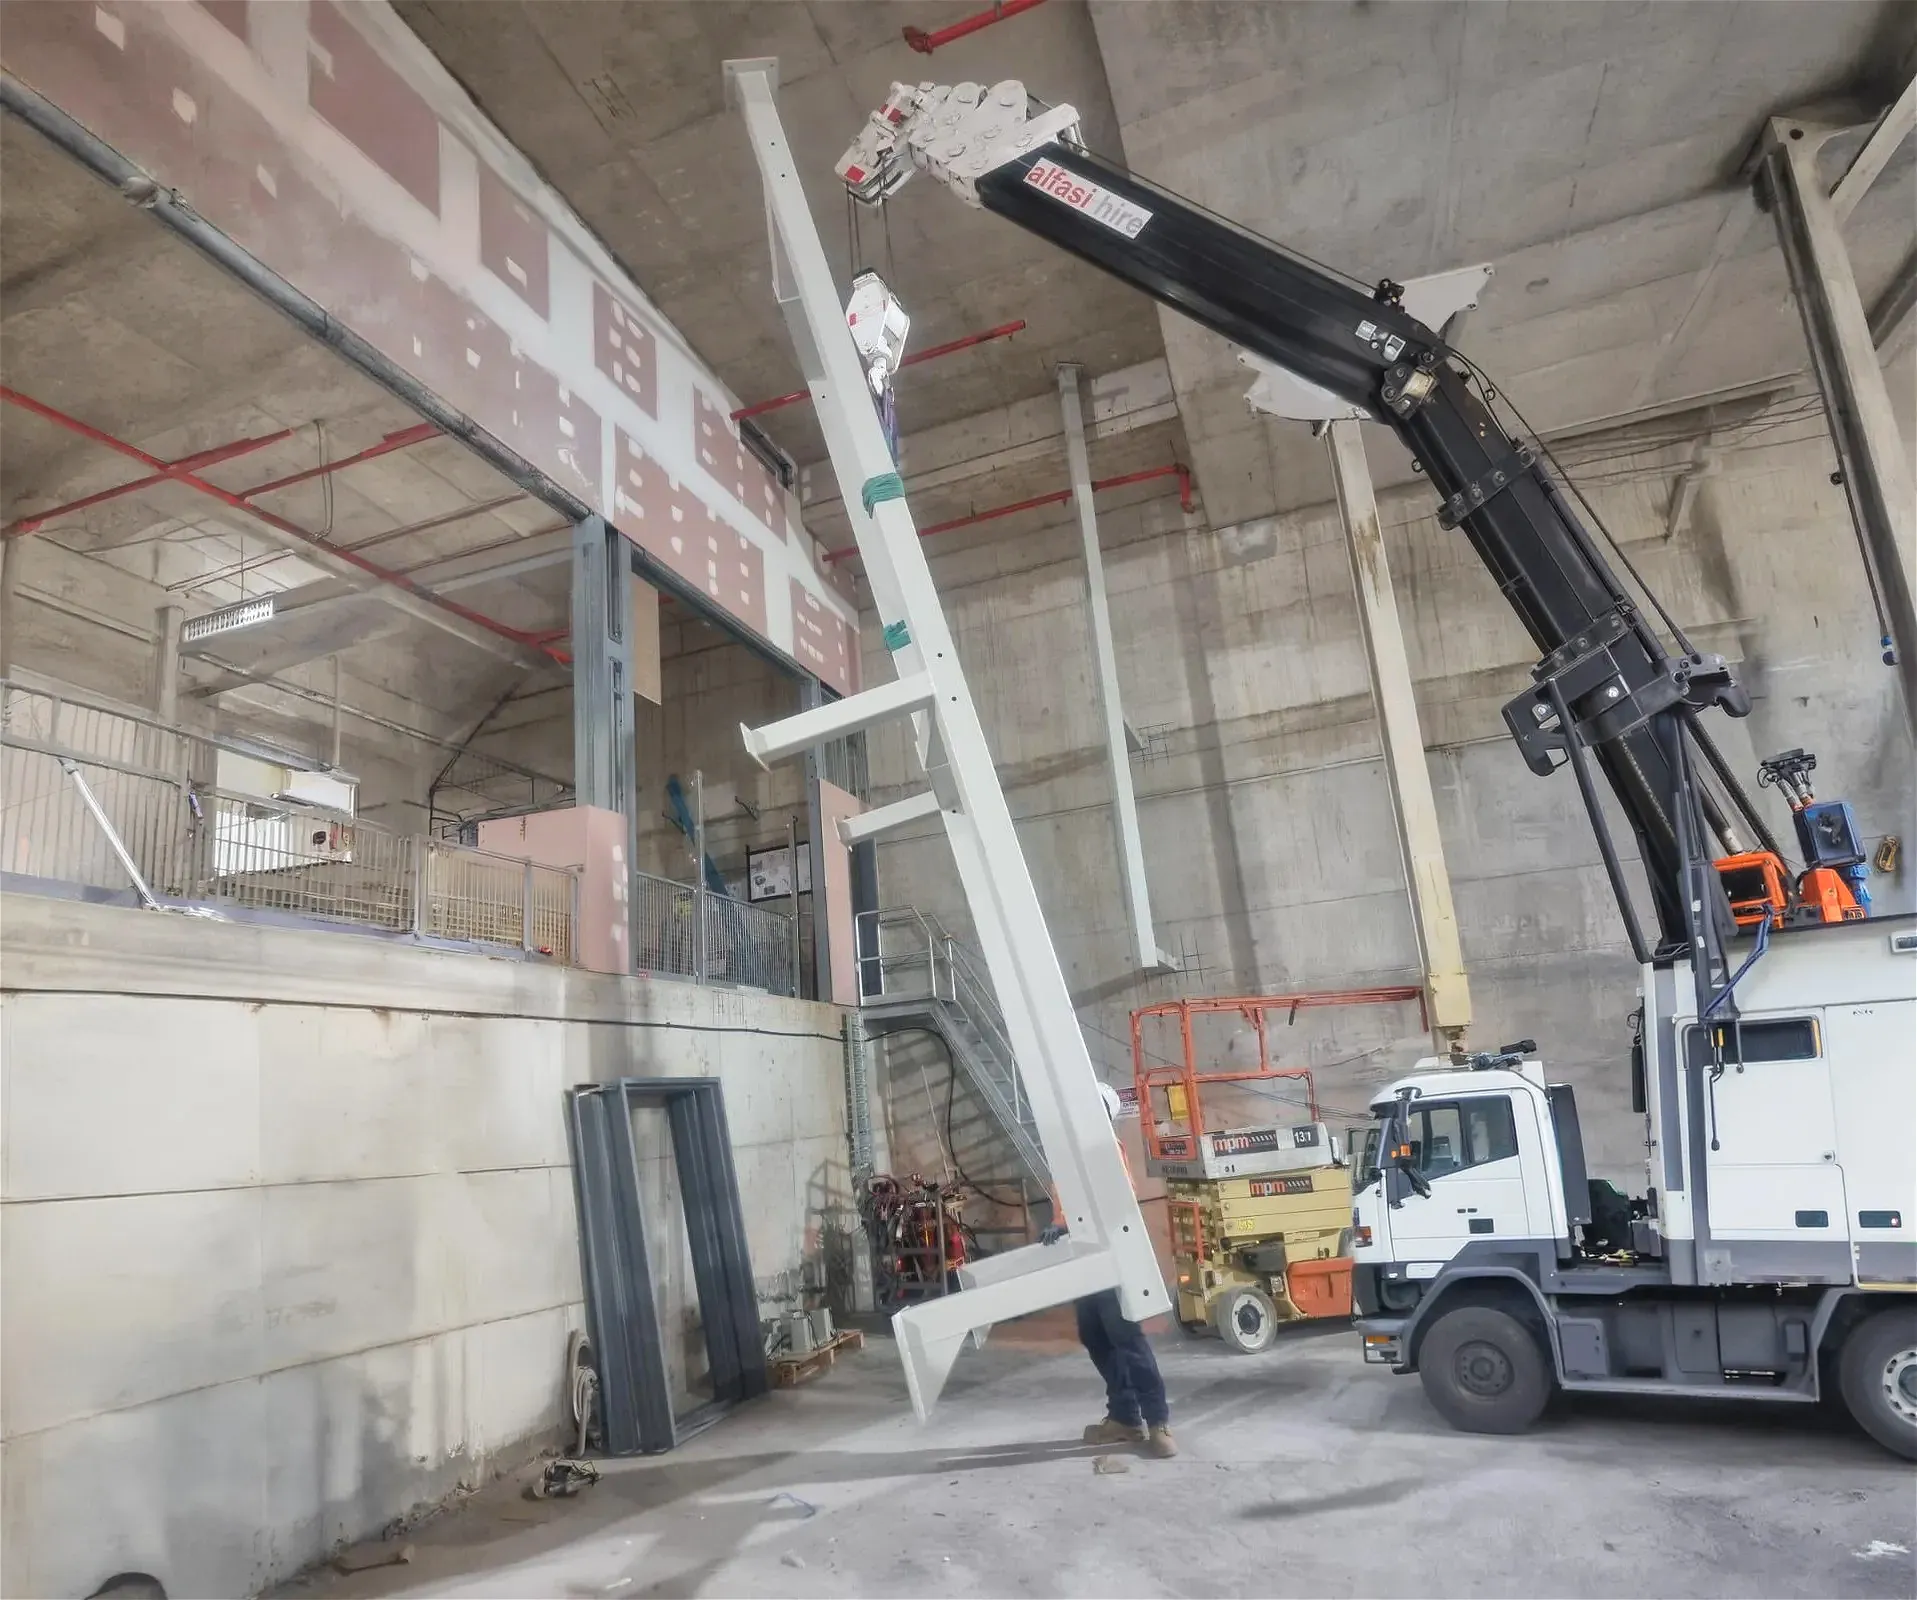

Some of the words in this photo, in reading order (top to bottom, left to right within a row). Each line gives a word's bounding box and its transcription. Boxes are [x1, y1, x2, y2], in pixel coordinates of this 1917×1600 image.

[1028, 166, 1097, 208] alfasi
[1094, 194, 1143, 233] hire
[1214, 1136, 1249, 1153] mpm
[1251, 1180, 1286, 1198] mpm
